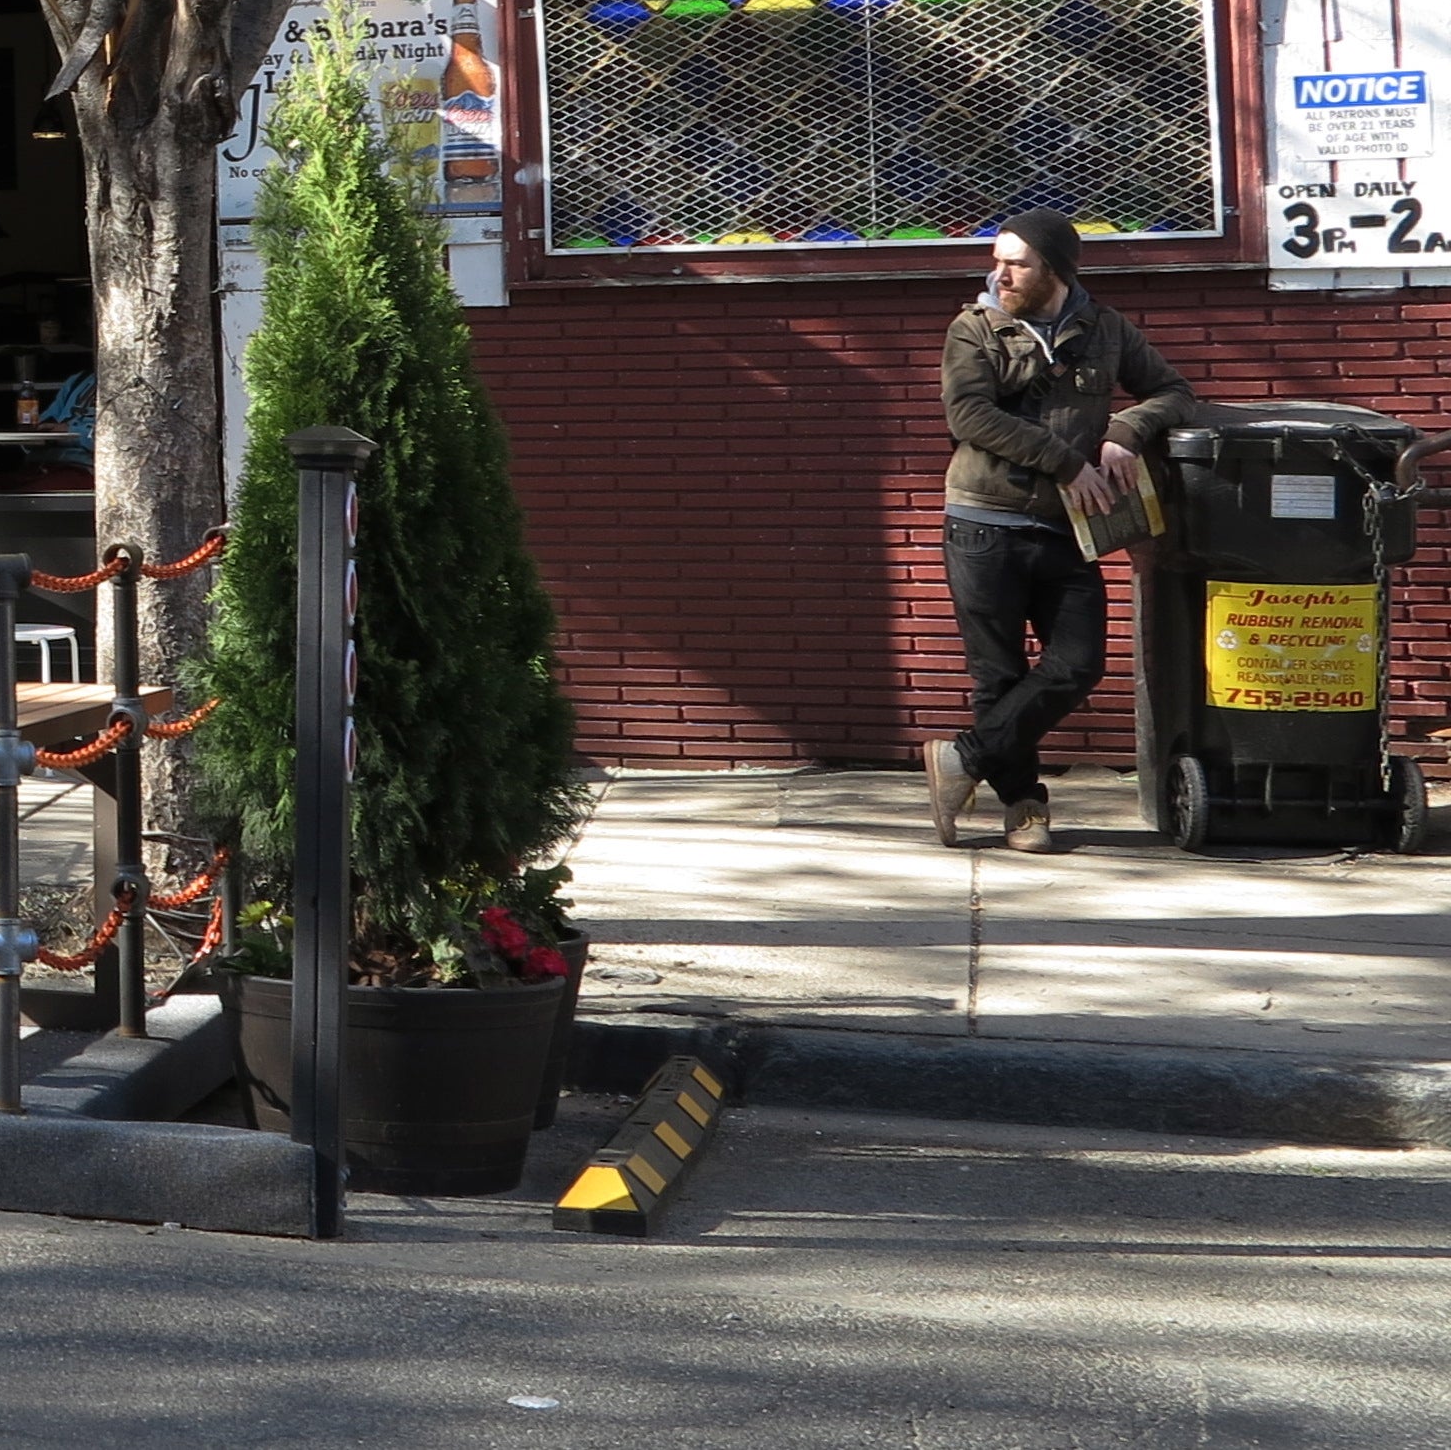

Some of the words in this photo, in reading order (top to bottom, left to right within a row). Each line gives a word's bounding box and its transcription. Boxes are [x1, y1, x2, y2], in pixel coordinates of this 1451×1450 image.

[284, 20, 306, 43] &
[392, 42, 445, 63] Night
[1299, 75, 1421, 104] NOTICE
[1305, 110, 1325, 121] ALL
[1329, 108, 1381, 120] PATRONS
[1384, 106, 1418, 118] MUST
[1308, 122, 1323, 133] BE
[1326, 121, 1356, 132] OVER
[1360, 120, 1374, 130] 21
[1378, 119, 1416, 129] YEARS
[1326, 132, 1340, 143] OF
[1344, 132, 1366, 142] AGE
[1370, 131, 1399, 142] WITH
[1317, 144, 1349, 156] VALID
[1355, 143, 1392, 154] PHOTO
[1396, 142, 1409, 153] ID
[229, 166, 249, 179] No
[1278, 181, 1338, 199] OPEN
[1354, 180, 1418, 198] DAILY
[1245, 589, 1351, 609] Joseph's
[1226, 613, 1295, 628] RUBBISH
[1301, 616, 1364, 629] REMOVAL
[1249, 633, 1259, 646] &
[1267, 634, 1347, 647] RECYCLING
[1311, 659, 1356, 671] SERVICE
[1321, 673, 1356, 686] RATES
[1224, 687, 1364, 707] 755-2940
